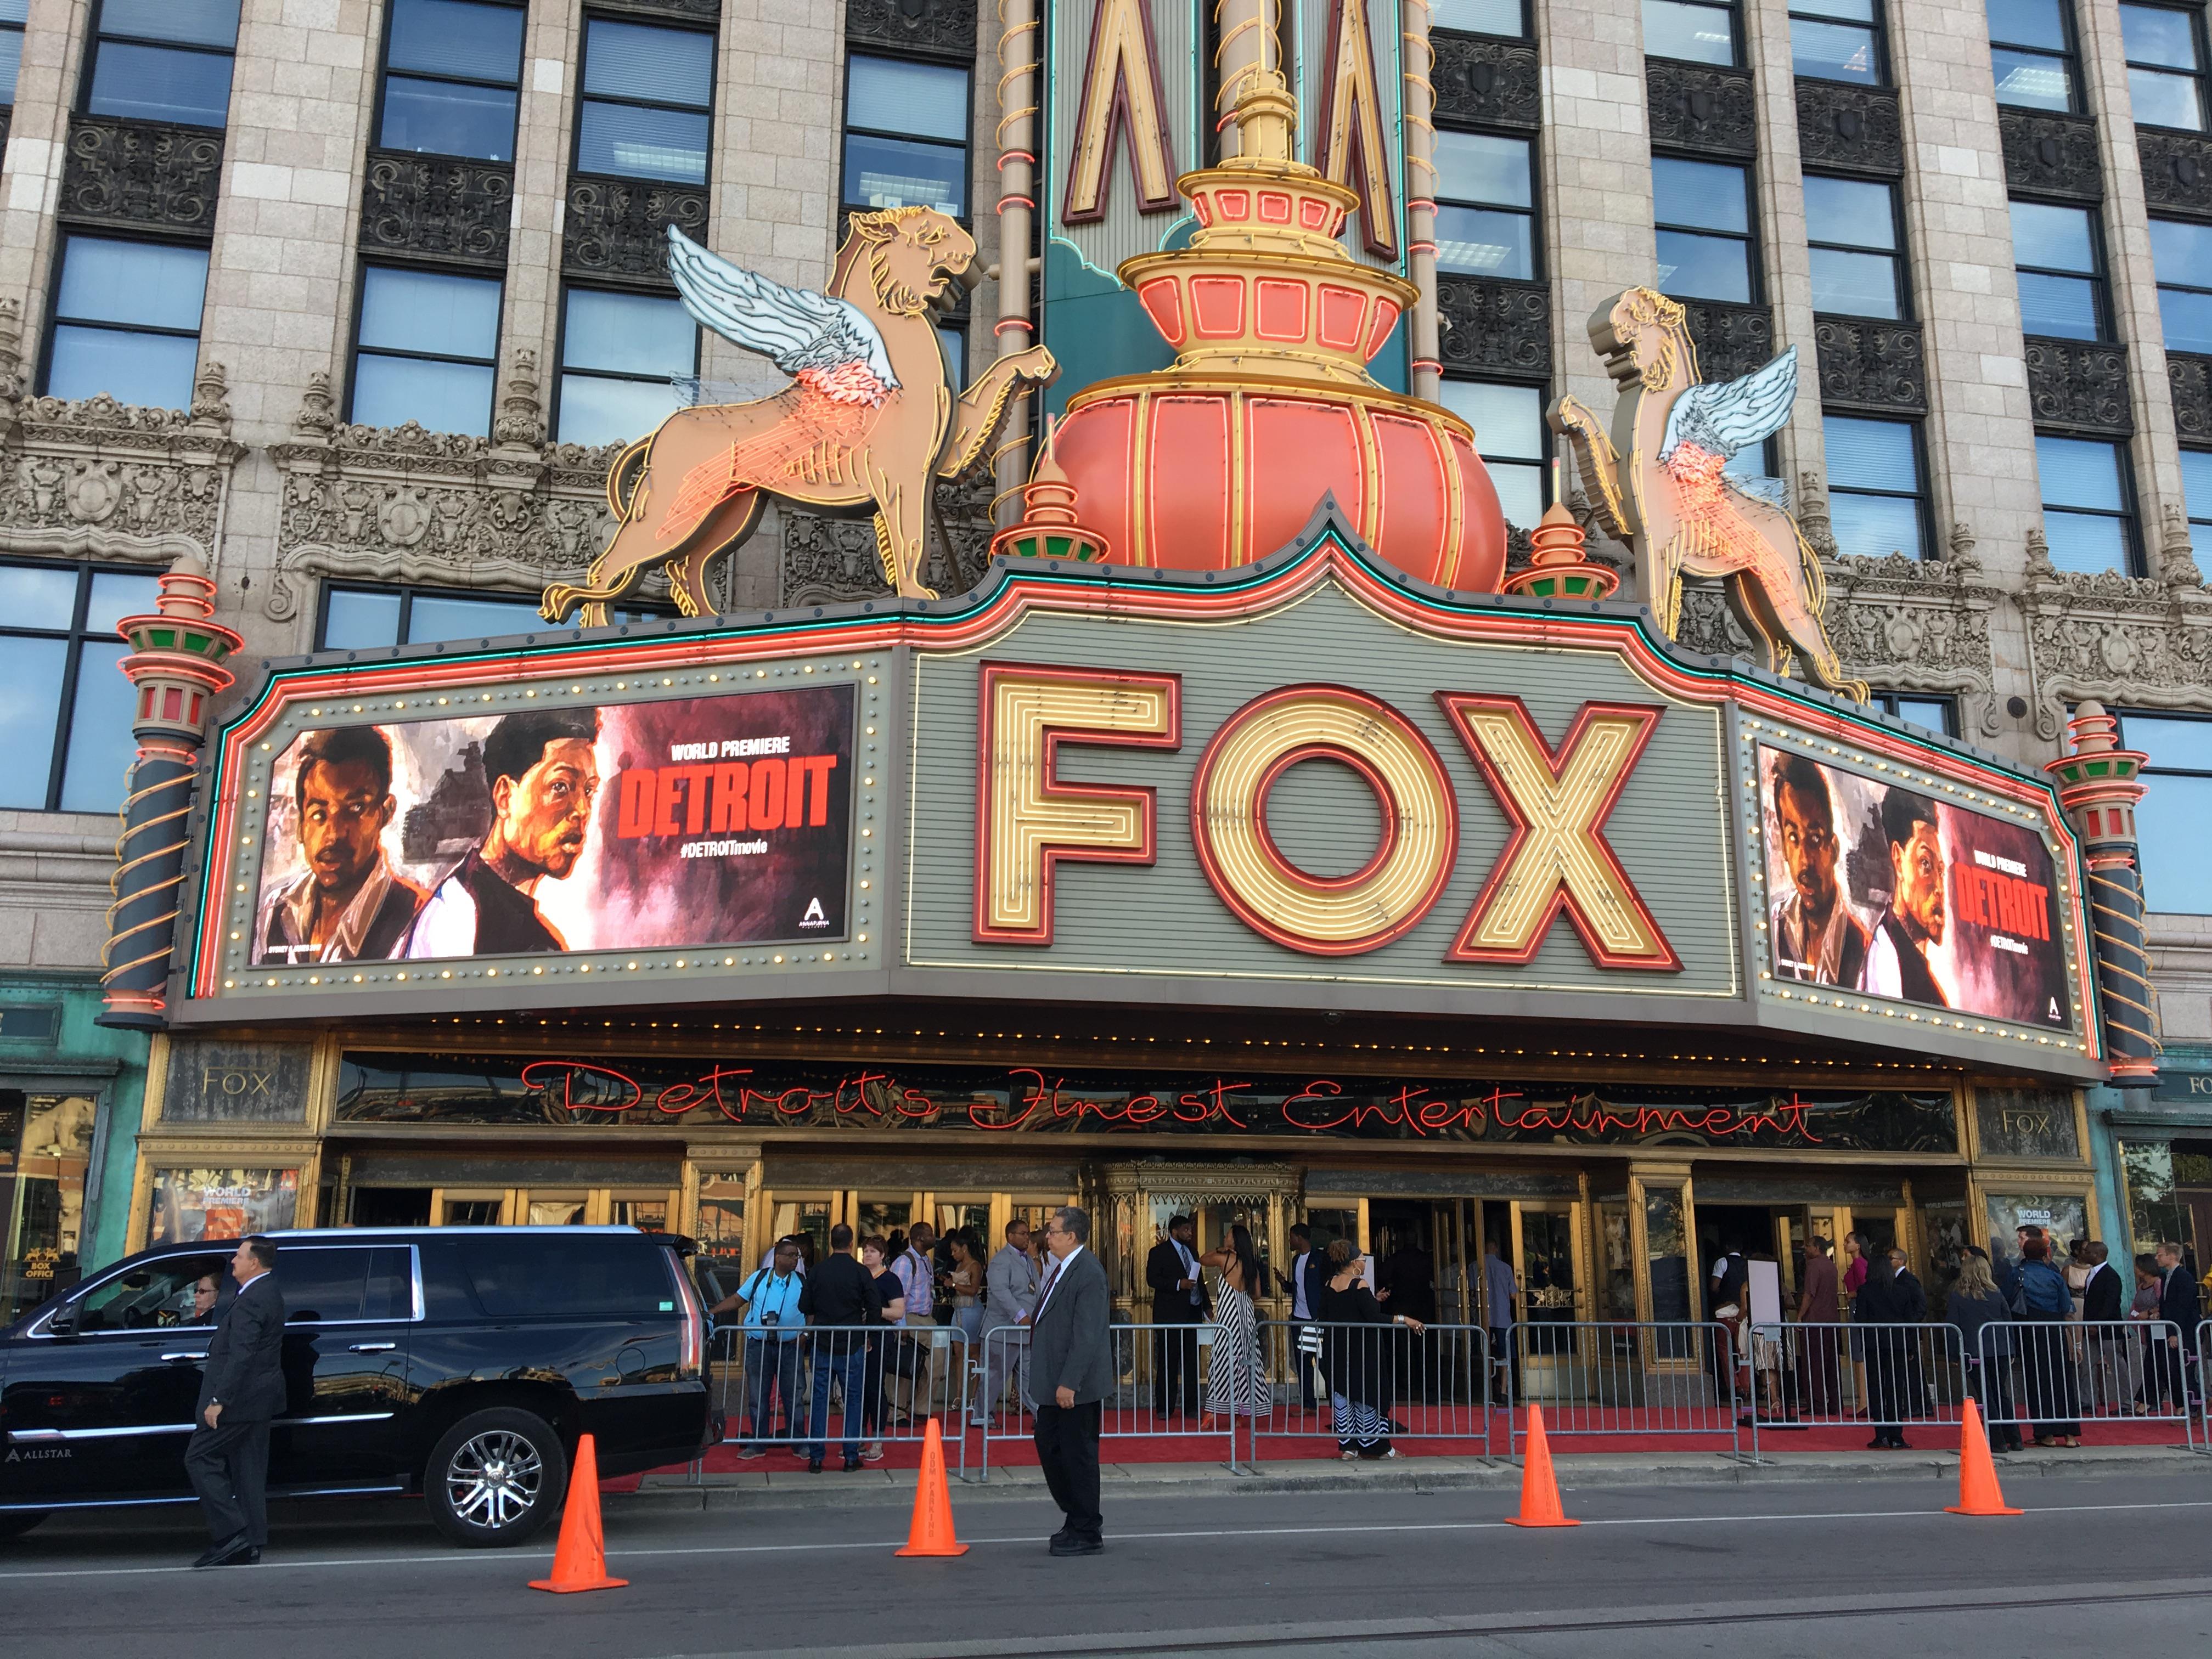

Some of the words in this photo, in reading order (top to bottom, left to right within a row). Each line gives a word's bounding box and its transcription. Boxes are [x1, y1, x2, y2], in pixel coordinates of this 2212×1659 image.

[671, 741, 718, 761] WORLD
[721, 736, 790, 758] PREMIERE
[617, 754, 837, 839] DETROIT
[971, 659, 1686, 973] FOX
[680, 838, 768, 859] #DETROITmovie
[1955, 861, 2051, 942] DETROIT
[203, 1066, 274, 1096] FOX
[521, 1061, 939, 1122] Detroit's
[969, 1068, 1252, 1129] Finest
[1283, 1080, 1823, 1142] Entertainment
[2003, 1110, 2052, 1137] FOX
[204, 1186, 251, 1197] WORLD
[2016, 1209, 2051, 1218] WORLD
[24, 1448, 72, 1459] ALLSTAR
